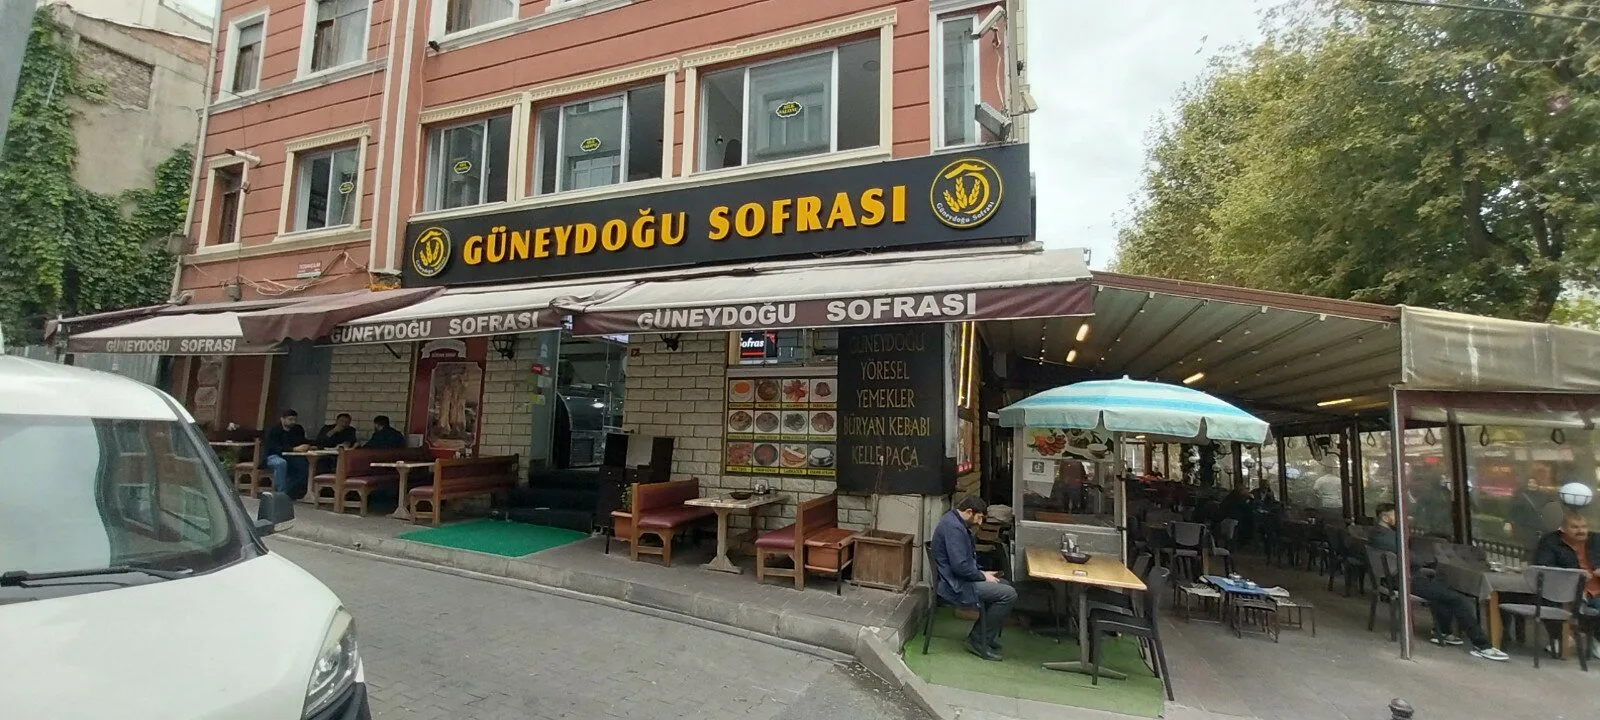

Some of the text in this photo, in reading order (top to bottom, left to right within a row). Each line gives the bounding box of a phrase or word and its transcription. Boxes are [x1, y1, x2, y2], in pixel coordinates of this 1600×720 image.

[463, 184, 907, 265] GÜNEYDOĞU SOFRASI
[936, 201, 995, 224] Güneydoğu Sofrası
[448, 311, 539, 335] SOFRASI
[636, 292, 977, 330] GÜNEYDOĞU SOFRASI
[180, 338, 237, 352] SOFRASI
[860, 358, 910, 380] YÖRESEL
[857, 388, 915, 408] YEMEKLER
[843, 412, 930, 437] BÜRYAN KEBABI
[852, 444, 919, 471] KELLE PAÇA
